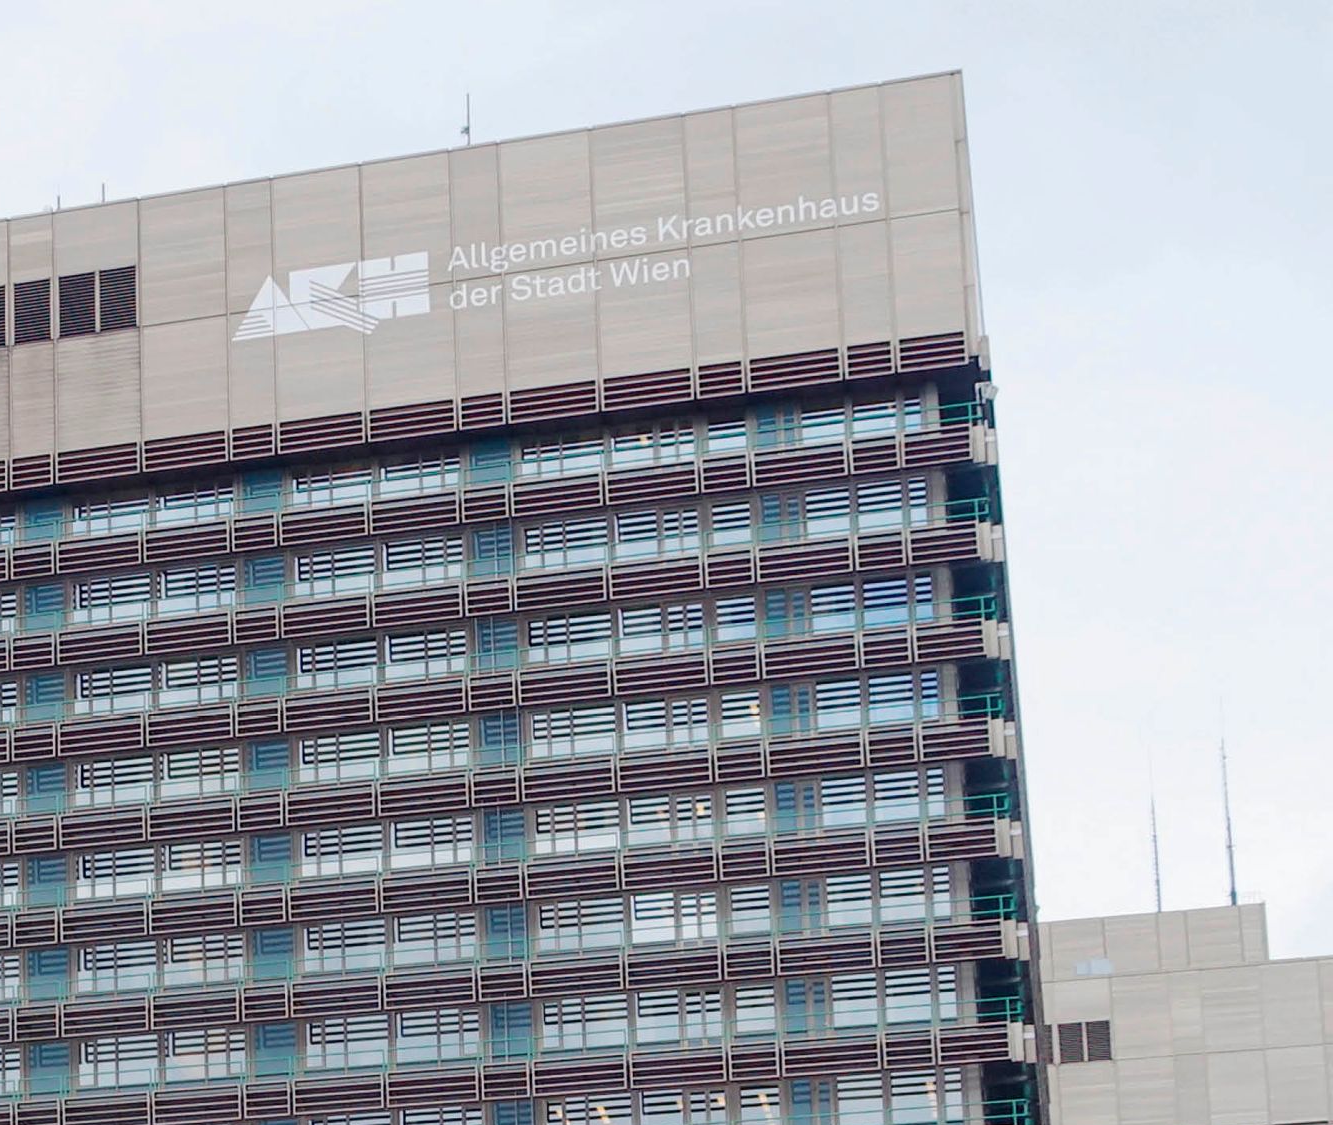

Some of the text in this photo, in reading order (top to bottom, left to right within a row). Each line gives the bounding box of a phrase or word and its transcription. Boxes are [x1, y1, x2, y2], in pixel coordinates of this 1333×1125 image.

[447, 191, 880, 272] Allgemeines Krankenhaus
[449, 256, 691, 310] der Stadt Wien
